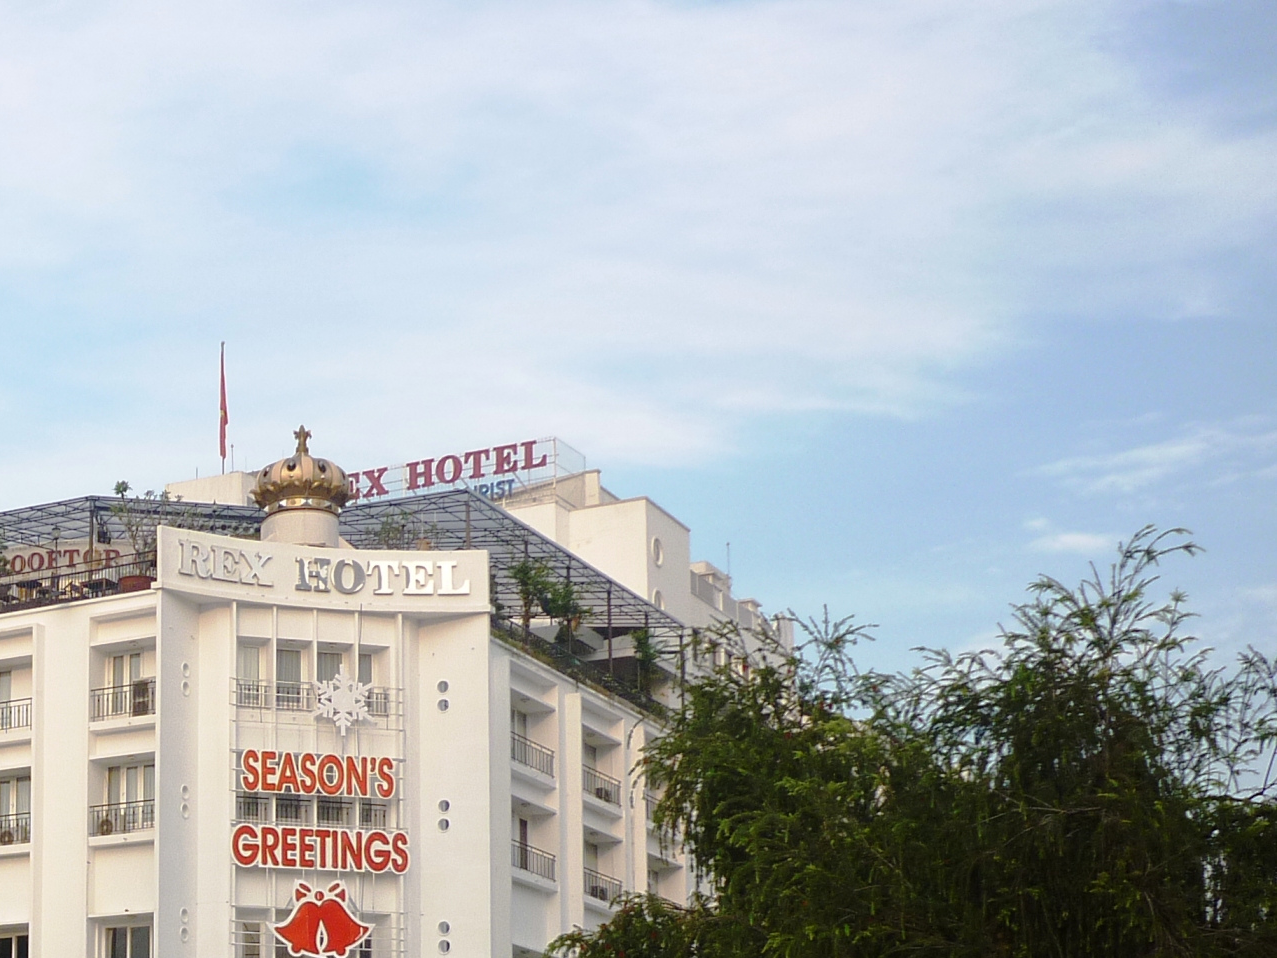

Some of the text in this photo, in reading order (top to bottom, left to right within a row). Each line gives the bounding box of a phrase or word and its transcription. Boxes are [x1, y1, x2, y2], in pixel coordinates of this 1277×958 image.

[347, 440, 547, 500] EX HOTEL
[2, 549, 121, 574] OOFTOP
[178, 538, 470, 595] REX HOTEL
[242, 749, 395, 798] SEASON'S
[232, 825, 409, 873] GREETINGS
